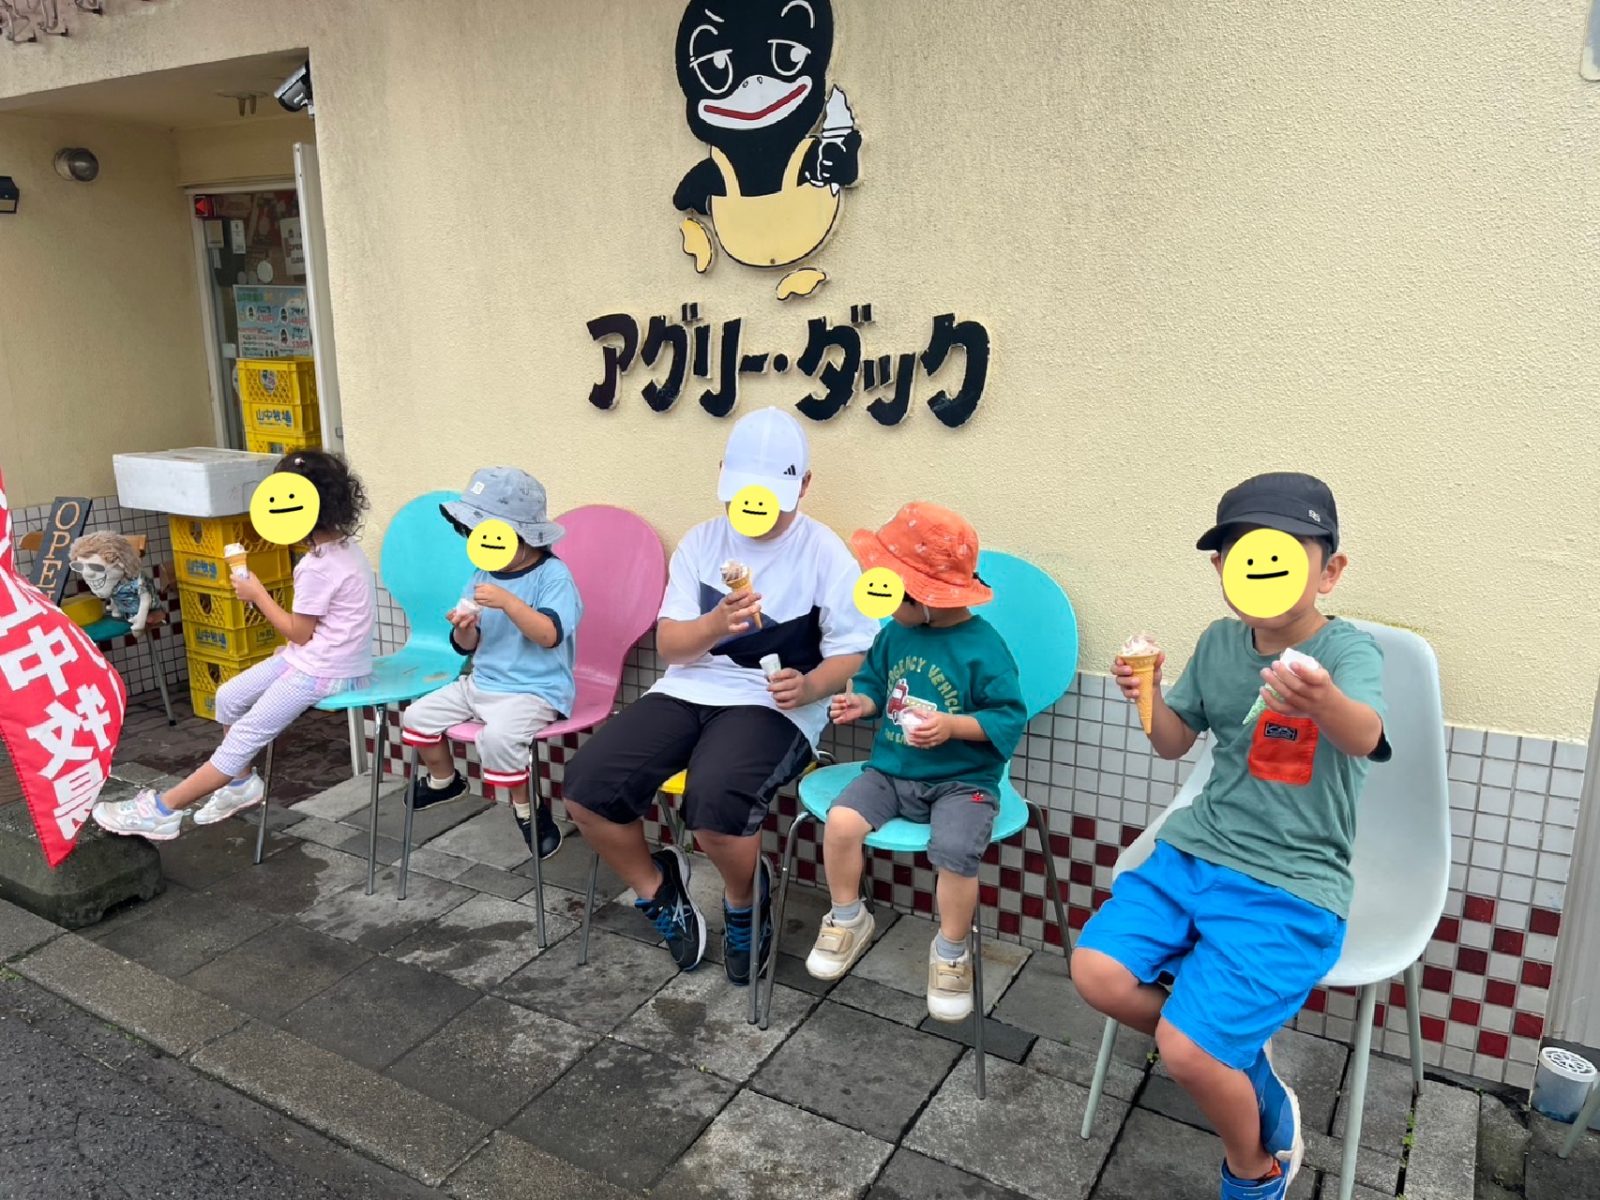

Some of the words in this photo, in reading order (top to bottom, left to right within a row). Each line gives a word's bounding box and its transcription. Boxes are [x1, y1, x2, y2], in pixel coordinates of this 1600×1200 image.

[587, 303, 989, 427] アグリー・ダック
[37, 501, 80, 600] OPE
[928, 664, 962, 714] VEHICL
